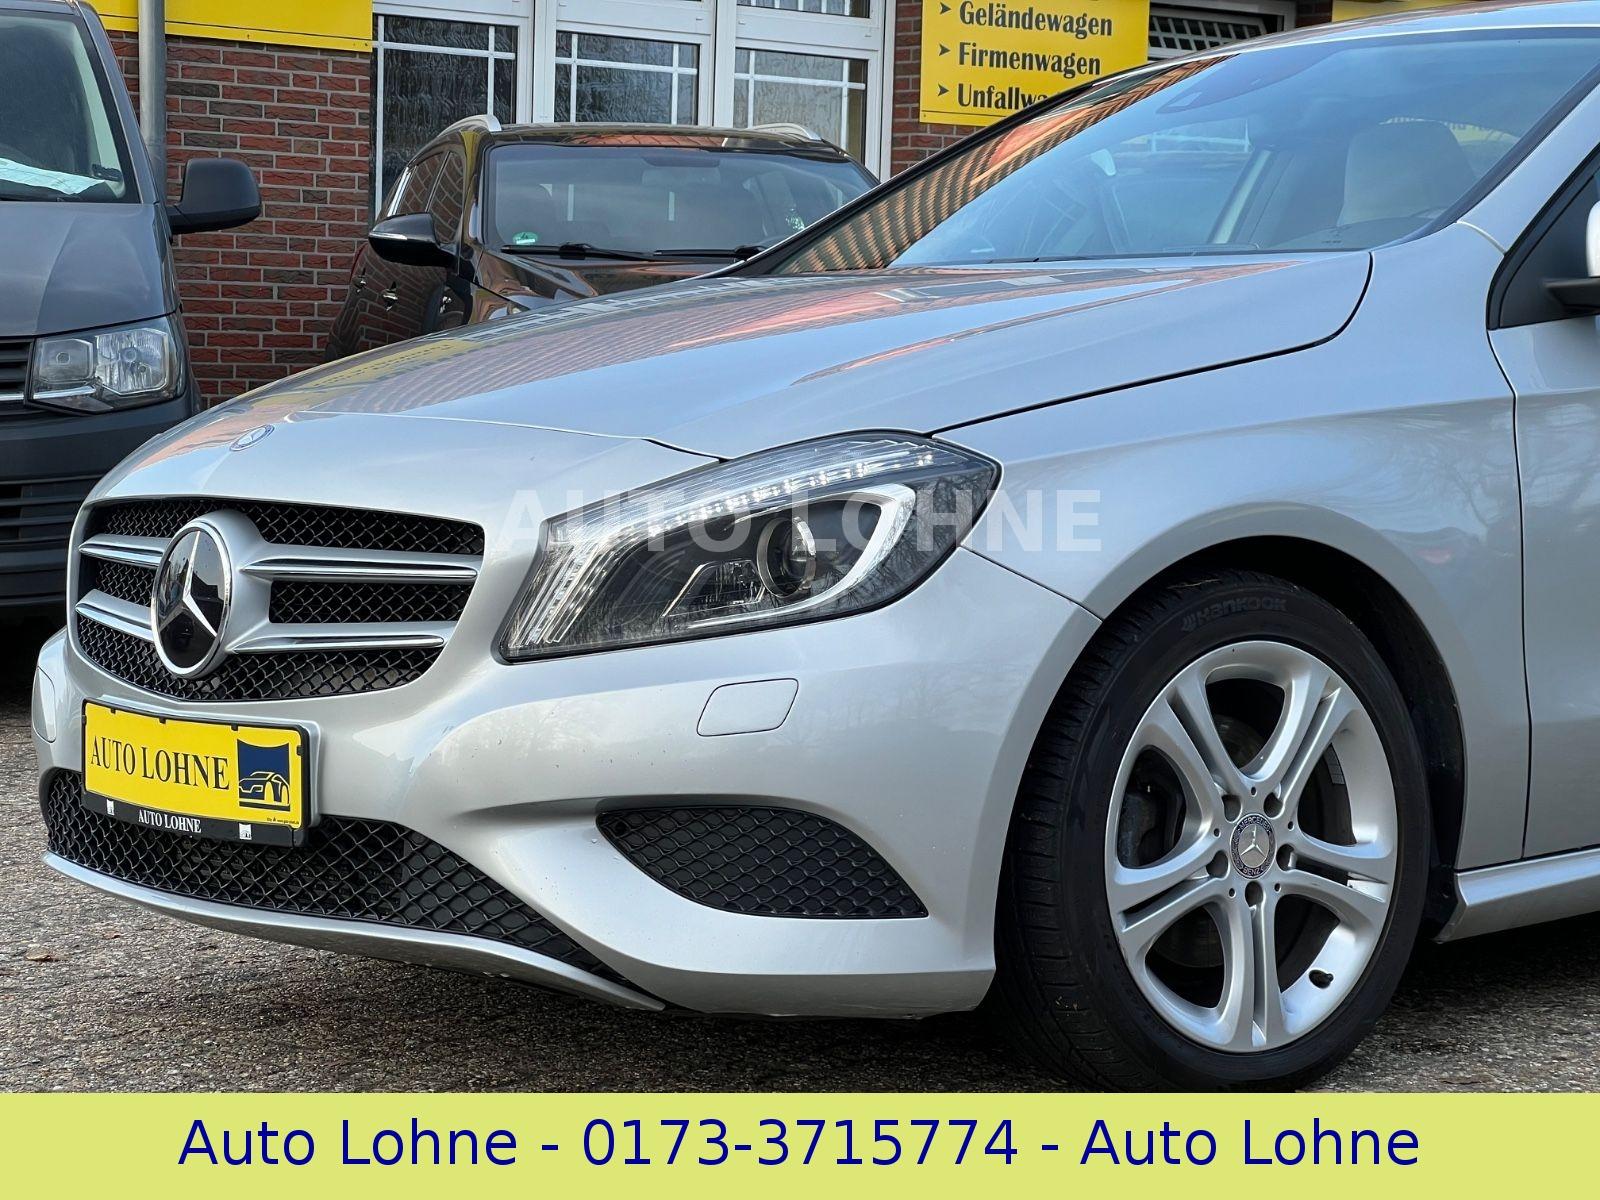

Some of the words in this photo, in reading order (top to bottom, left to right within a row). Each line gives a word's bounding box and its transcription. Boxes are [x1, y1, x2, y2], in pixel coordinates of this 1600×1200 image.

[960, 1, 1112, 39] Geländewagen
[959, 42, 1101, 78] Firmenwagen
[91, 736, 136, 775] AUTO
[141, 747, 230, 790] LOHNE
[138, 809, 162, 827] AUTO
[164, 814, 202, 833] LOHNE
